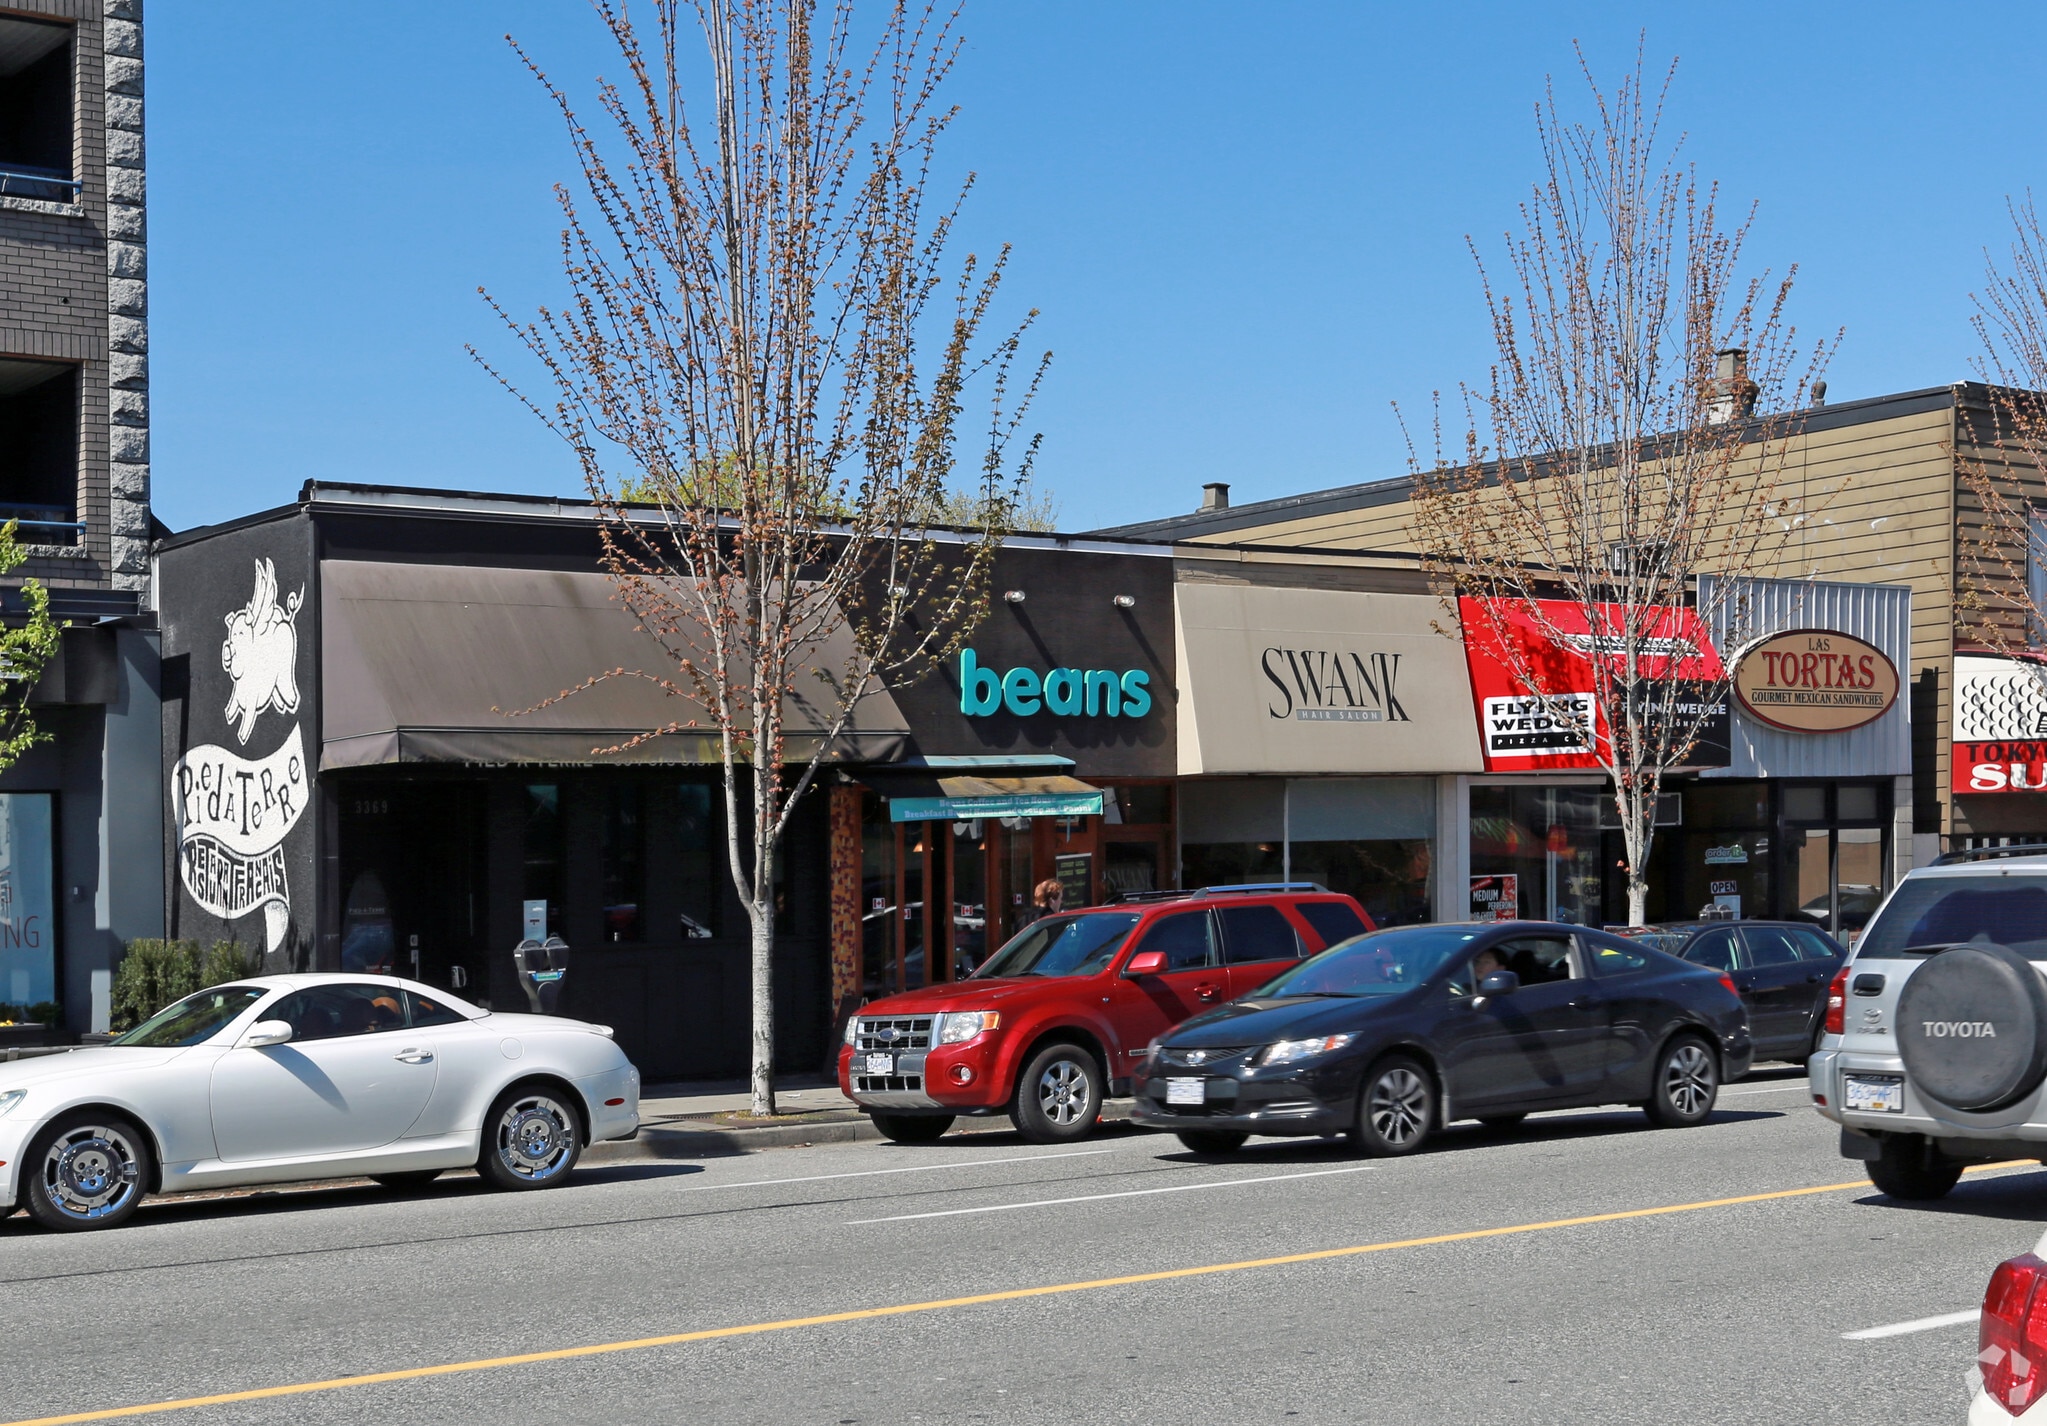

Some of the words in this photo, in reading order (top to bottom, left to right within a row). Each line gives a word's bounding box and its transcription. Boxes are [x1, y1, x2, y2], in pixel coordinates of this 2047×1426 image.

[1808, 637, 1831, 651] LAS
[1761, 651, 1875, 690] TORTAS
[960, 648, 1151, 717] beans
[1262, 645, 1414, 723] SWANK
[1751, 691, 1793, 703] GOURMET
[1794, 692, 1832, 704] MEXICAN
[1833, 694, 1884, 706] SANDWICHES
[1302, 711, 1331, 720] HAIR
[1339, 711, 1378, 720] SALON
[1497, 737, 1548, 745] PIZZA
[1966, 743, 2047, 763] TOKY
[904, 810, 946, 819] Breakfast
[1711, 881, 1736, 893] OPEN
[1472, 889, 1499, 902] MEDIUM
[1922, 1021, 1997, 1038] TOYOTA
